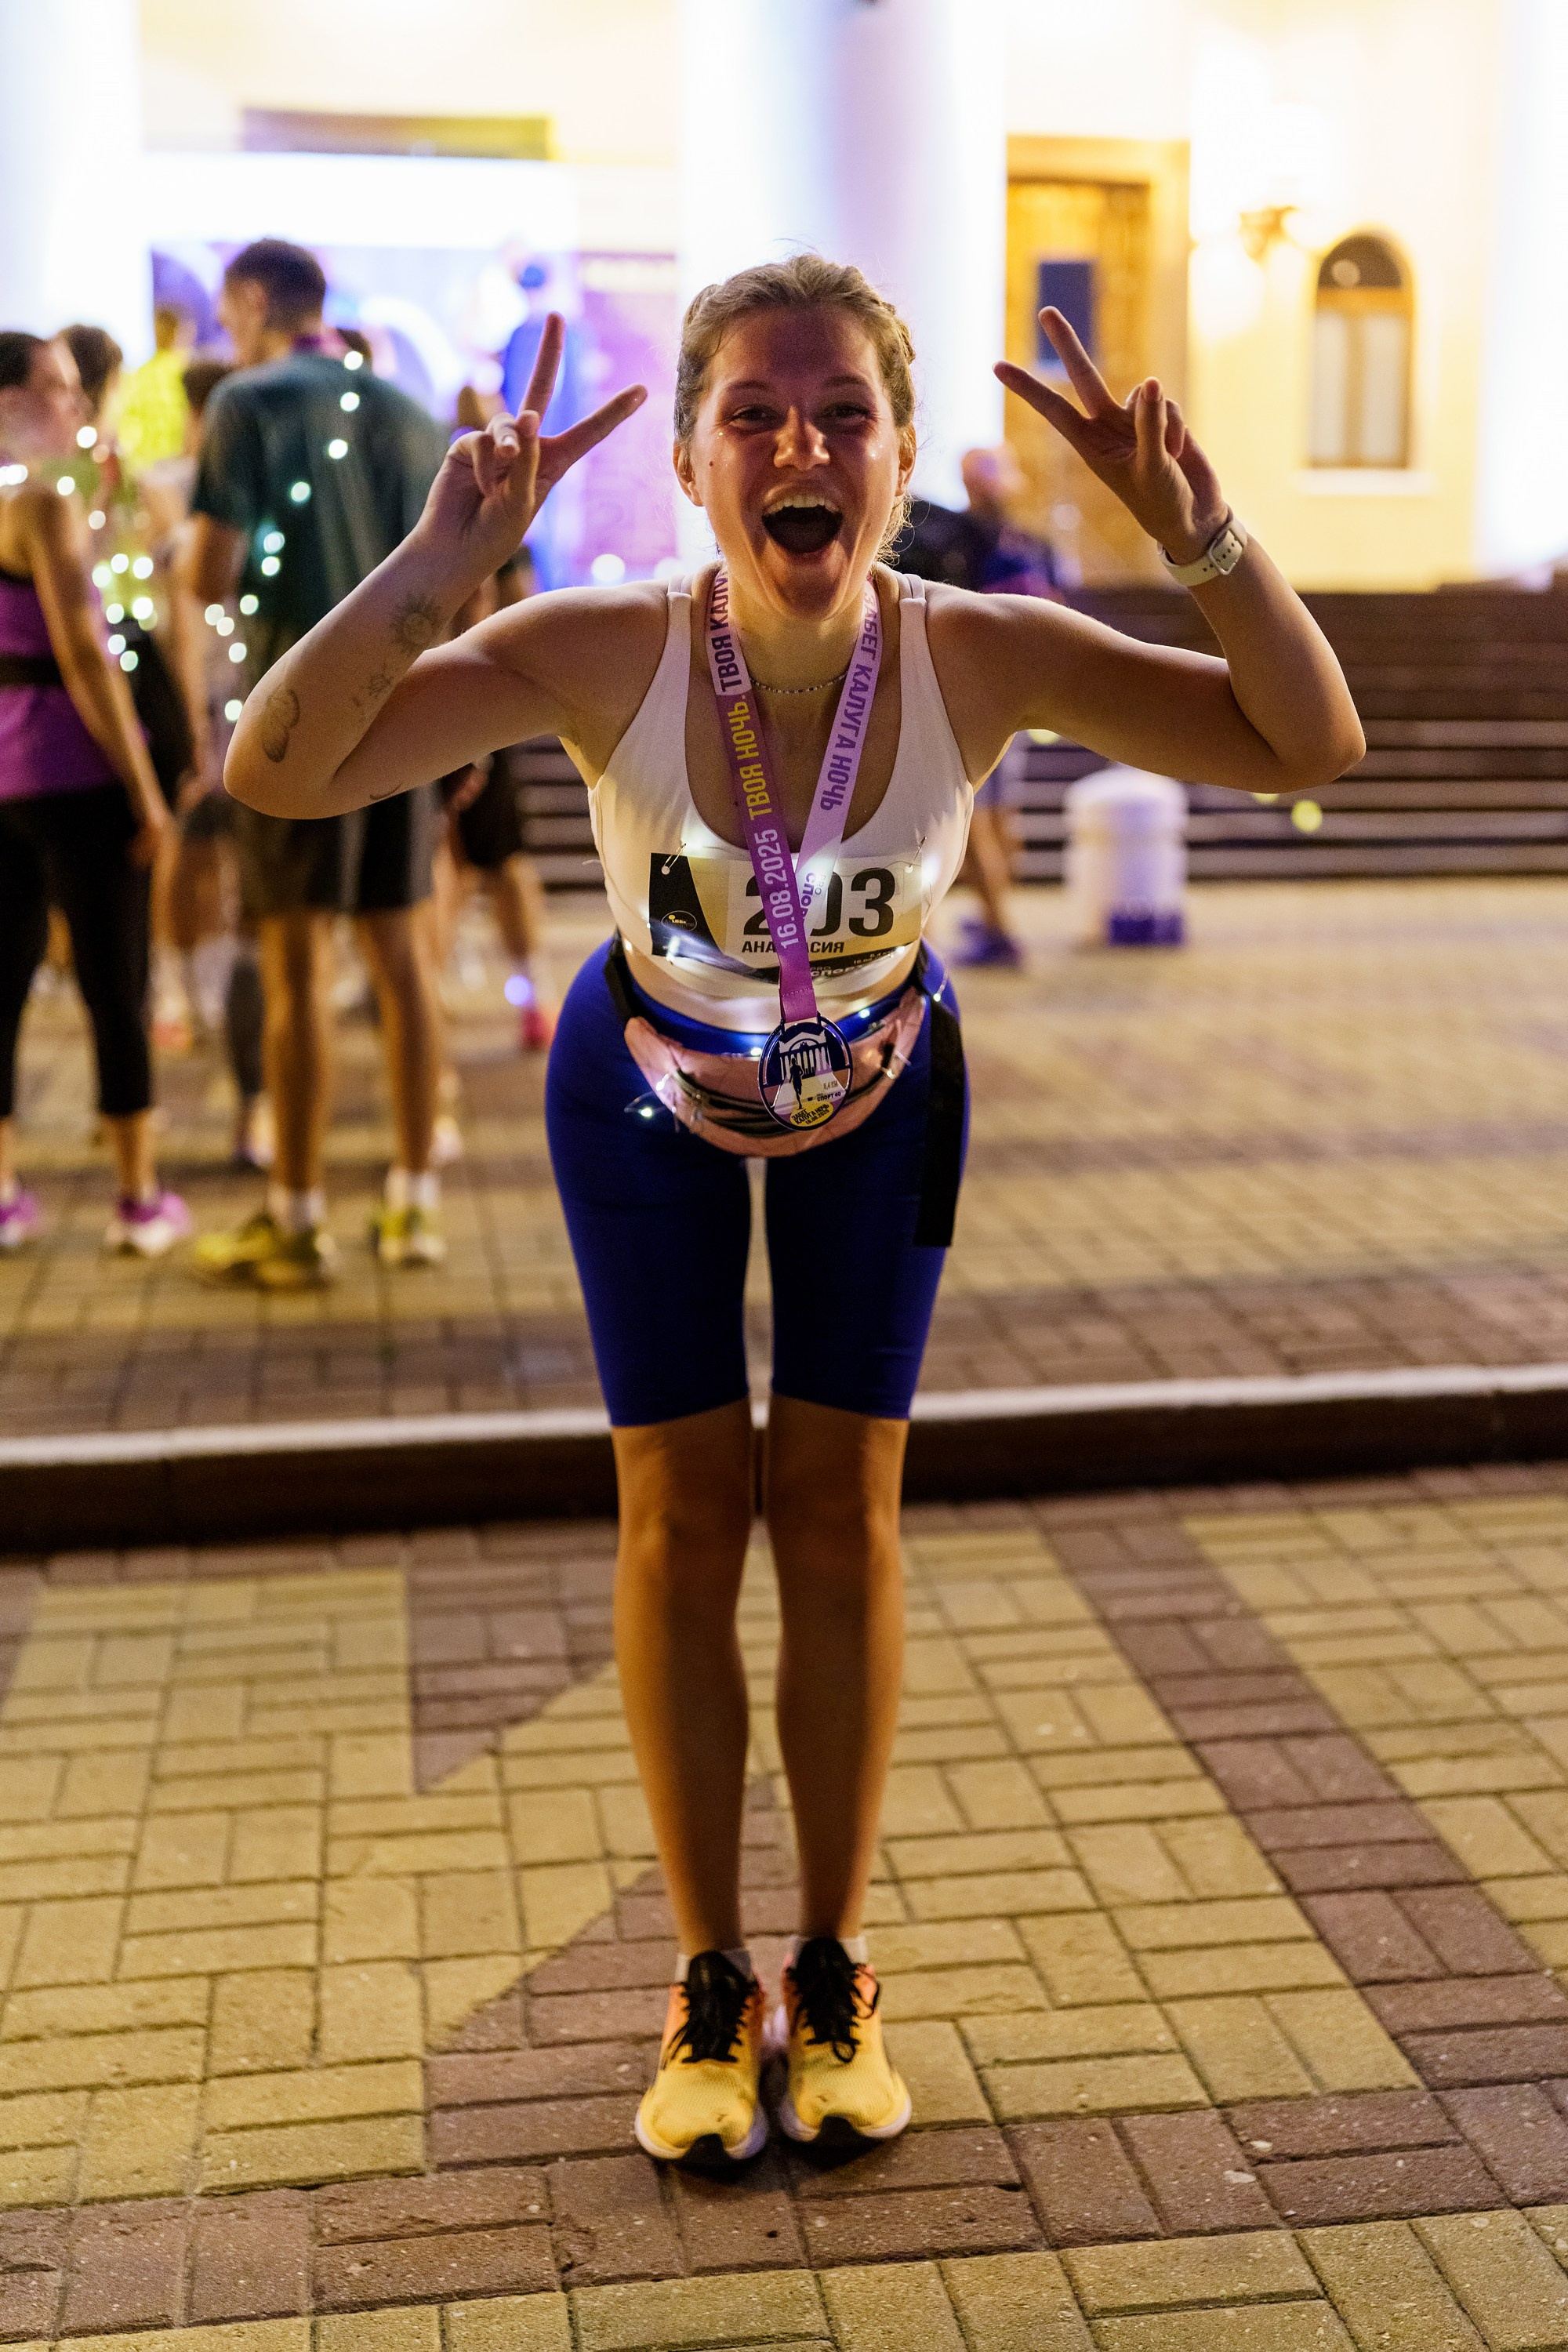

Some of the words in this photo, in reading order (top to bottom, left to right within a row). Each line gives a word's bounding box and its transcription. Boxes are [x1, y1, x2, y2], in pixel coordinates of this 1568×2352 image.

[710, 571, 729, 630] КАЛУ
[711, 634, 742, 692] ТВОЯ
[835, 664, 873, 750] КАЛУГА
[739, 764, 772, 821] ТВОЯ
[820, 754, 853, 811] НОЧЬ
[754, 829, 799, 949] 16.08.2025
[800, 872, 817, 919] СПОР
[742, 941, 844, 953] АНАСИЯ
[794, 1111, 815, 1124] КАЛУГА
[815, 1104, 829, 1114] НОЧЬ
[817, 1093, 834, 1102] СПОРТ
